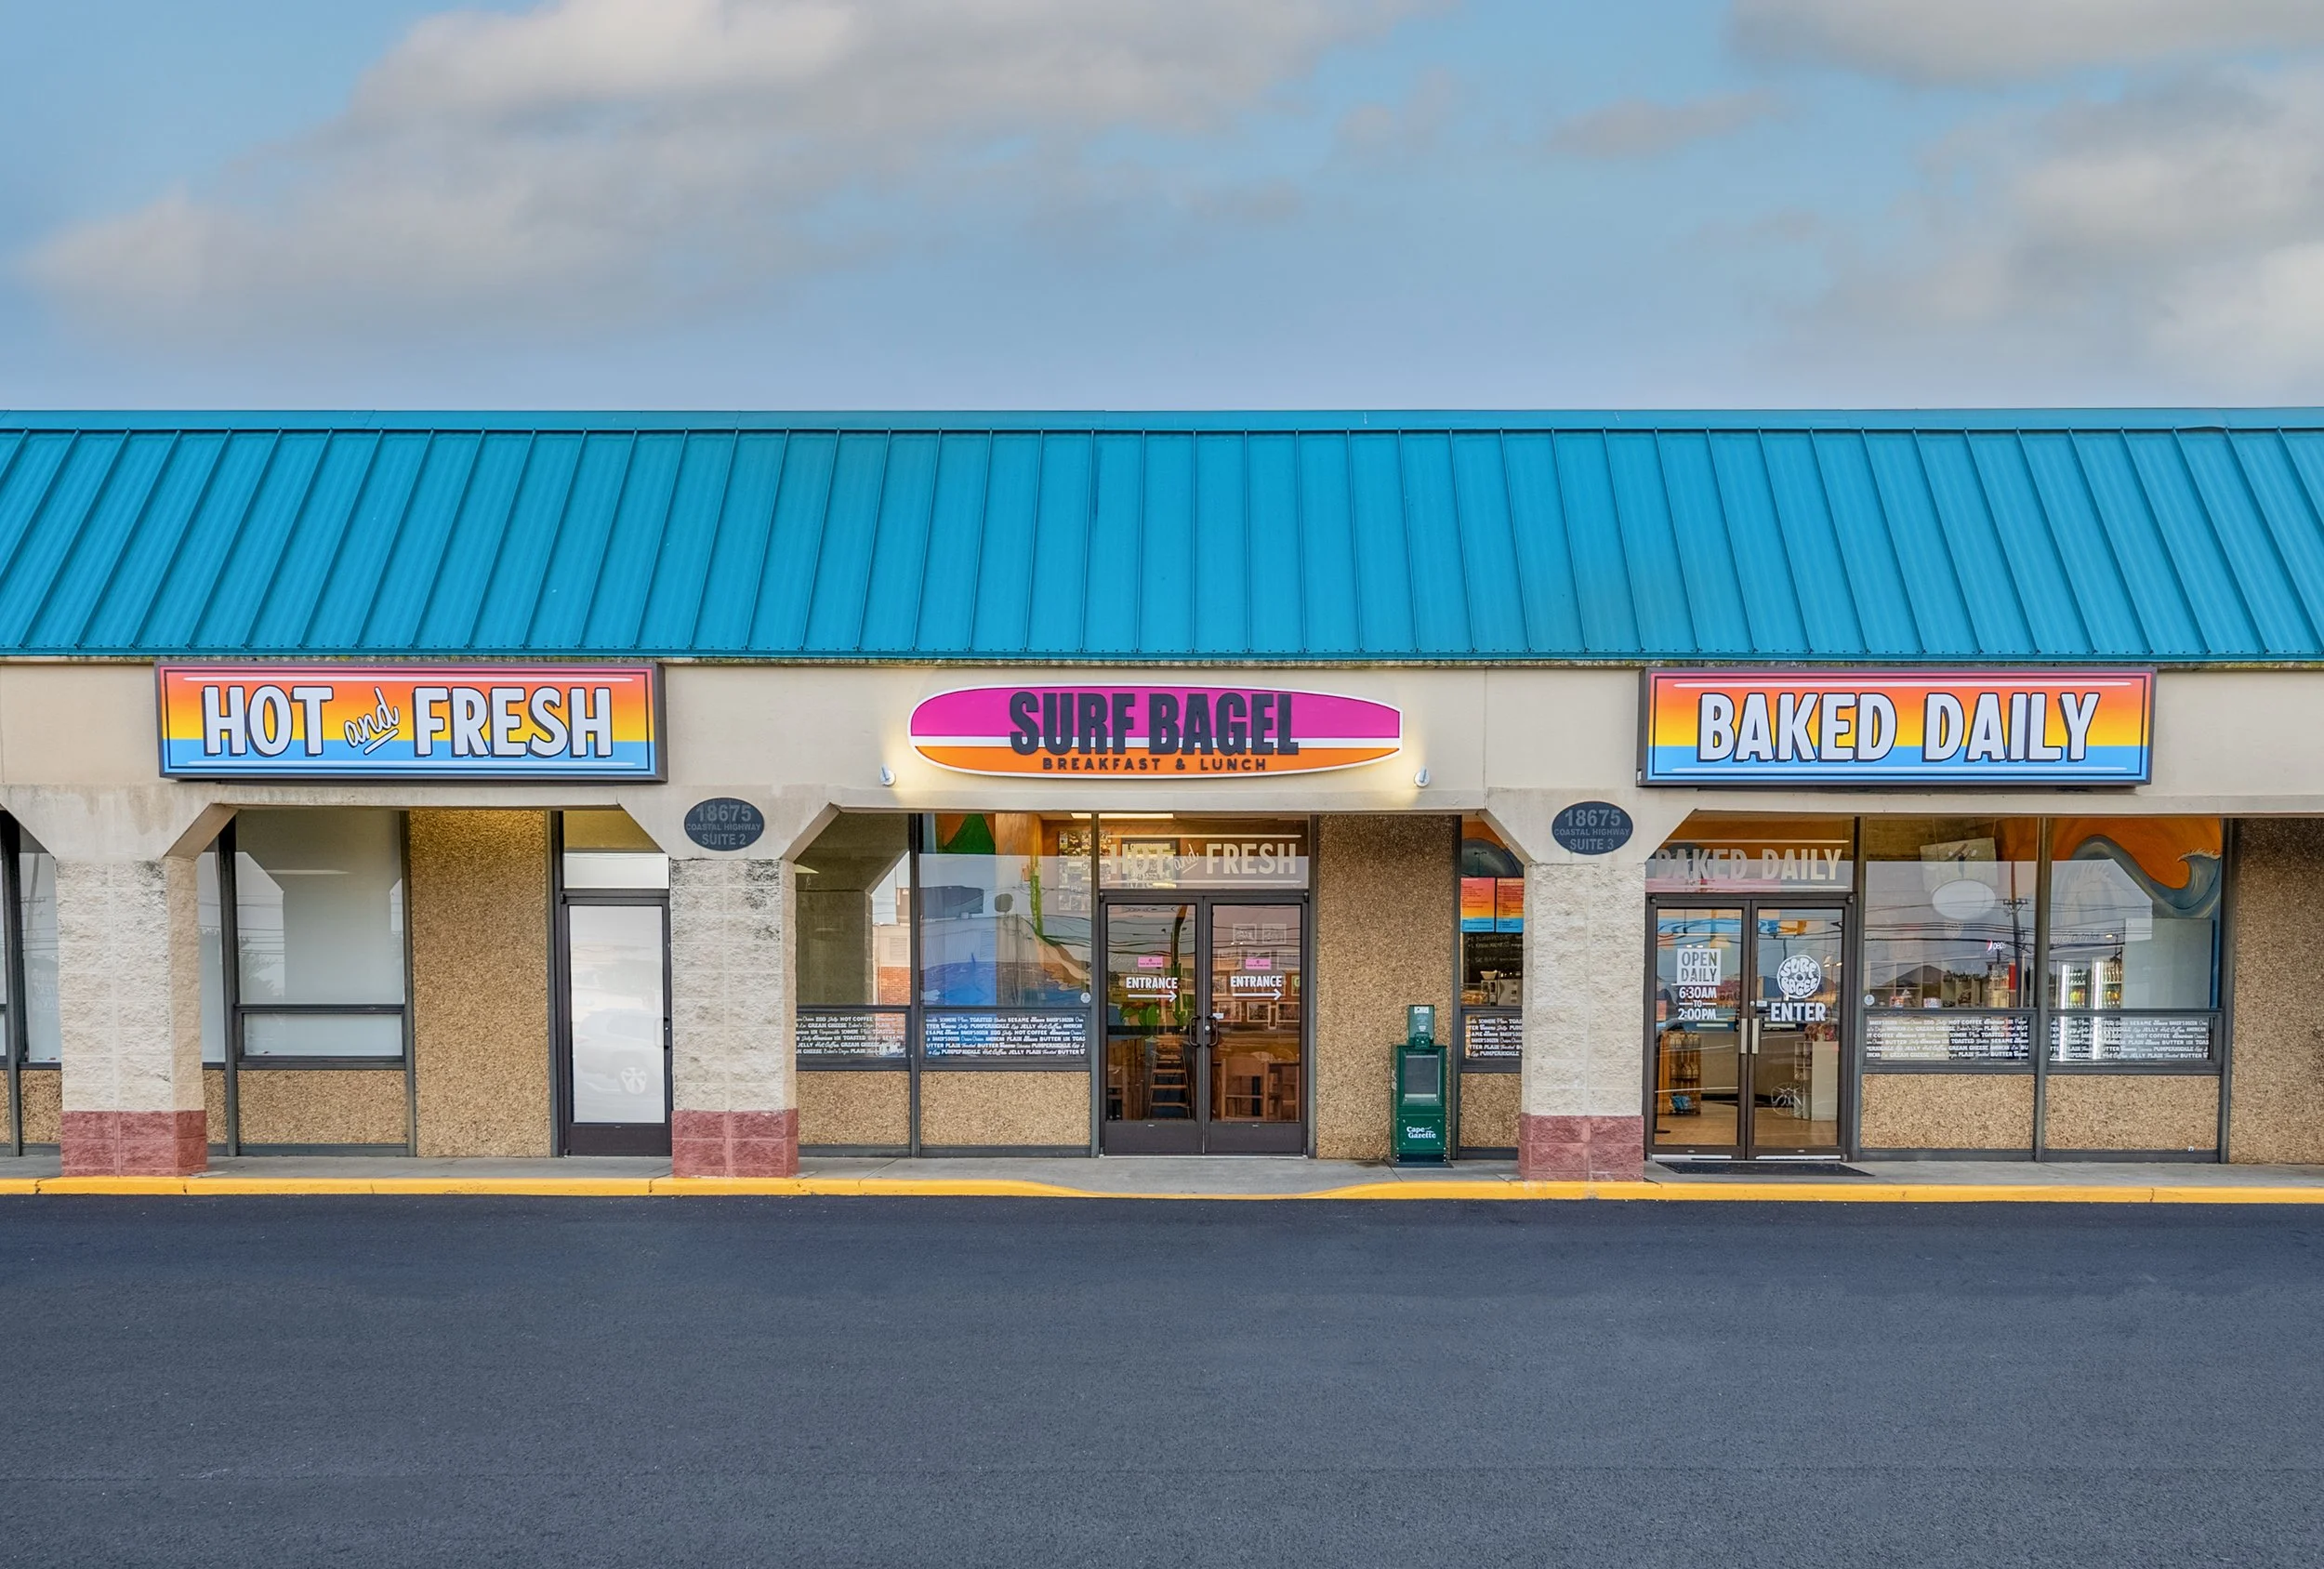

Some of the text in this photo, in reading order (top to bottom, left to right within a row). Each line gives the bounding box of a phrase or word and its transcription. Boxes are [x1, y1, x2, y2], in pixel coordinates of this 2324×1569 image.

[201, 685, 612, 758] HOT and FRESH
[1009, 691, 1299, 757] SURF BAGEL
[1697, 692, 2101, 763] BAKED DAILY
[1043, 757, 1267, 771] BREAKFAST & LUNCH
[696, 805, 752, 822] 18675
[1565, 809, 1620, 827] 18675
[702, 834, 746, 845] SUITE 2
[1570, 838, 1614, 850] SUITE 3
[1110, 843, 1170, 875] HOT
[1173, 844, 1199, 871] and
[1206, 843, 1296, 875] FRESH
[1655, 849, 1842, 880] BAKED DAILY
[1682, 952, 1717, 967] OPEN
[1779, 957, 1817, 979] SURF
[1126, 977, 1178, 989] ENTRANCE
[1230, 975, 1282, 987] ENTRANCE
[1681, 968, 1717, 982] DAILY
[1679, 986, 1717, 999] 6:30AM
[1780, 977, 1818, 996] BAGEL
[1678, 1009, 1717, 1020] 2:00PM
[1770, 1002, 1826, 1022] ENTER
